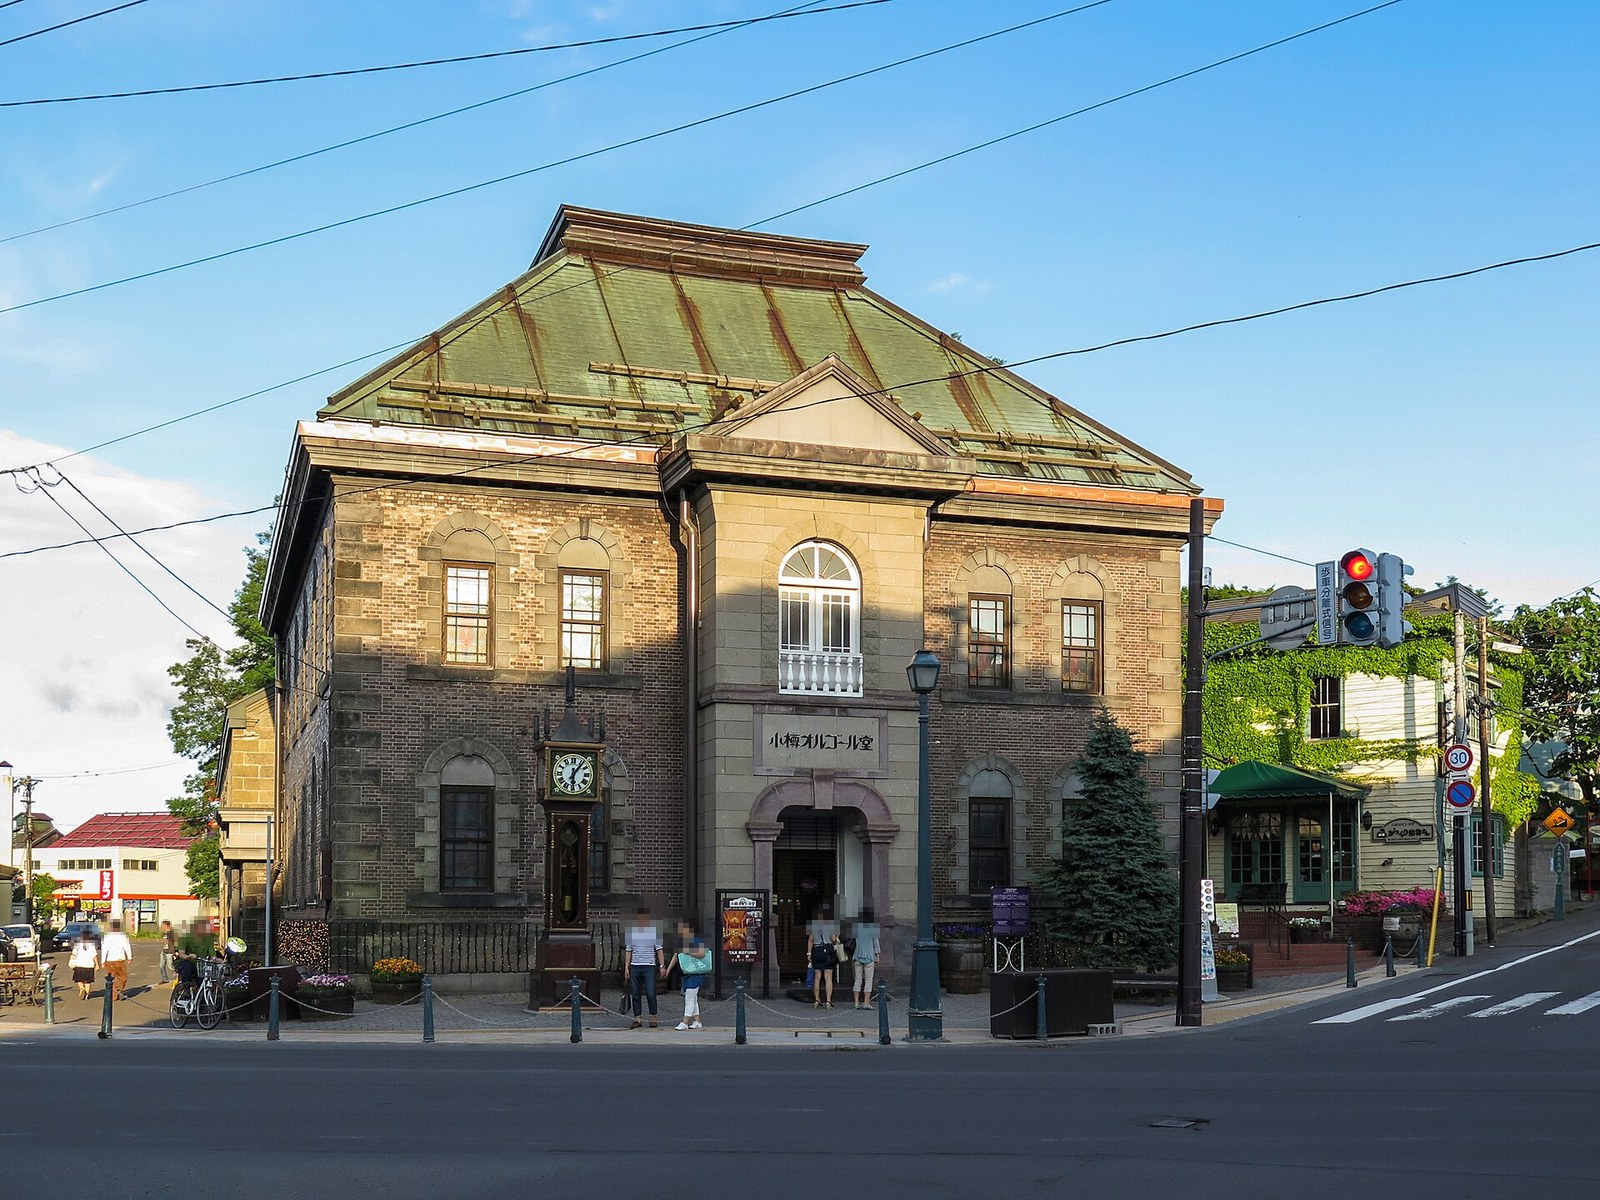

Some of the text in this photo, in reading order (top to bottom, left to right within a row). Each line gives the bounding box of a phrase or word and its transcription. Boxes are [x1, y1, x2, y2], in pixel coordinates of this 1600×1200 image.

[1321, 567, 1332, 640] 歩車分離式信号
[769, 732, 874, 751] 小樽オルゴール堂
[1450, 752, 1467, 765] 30
[102, 871, 111, 898] セルフ
